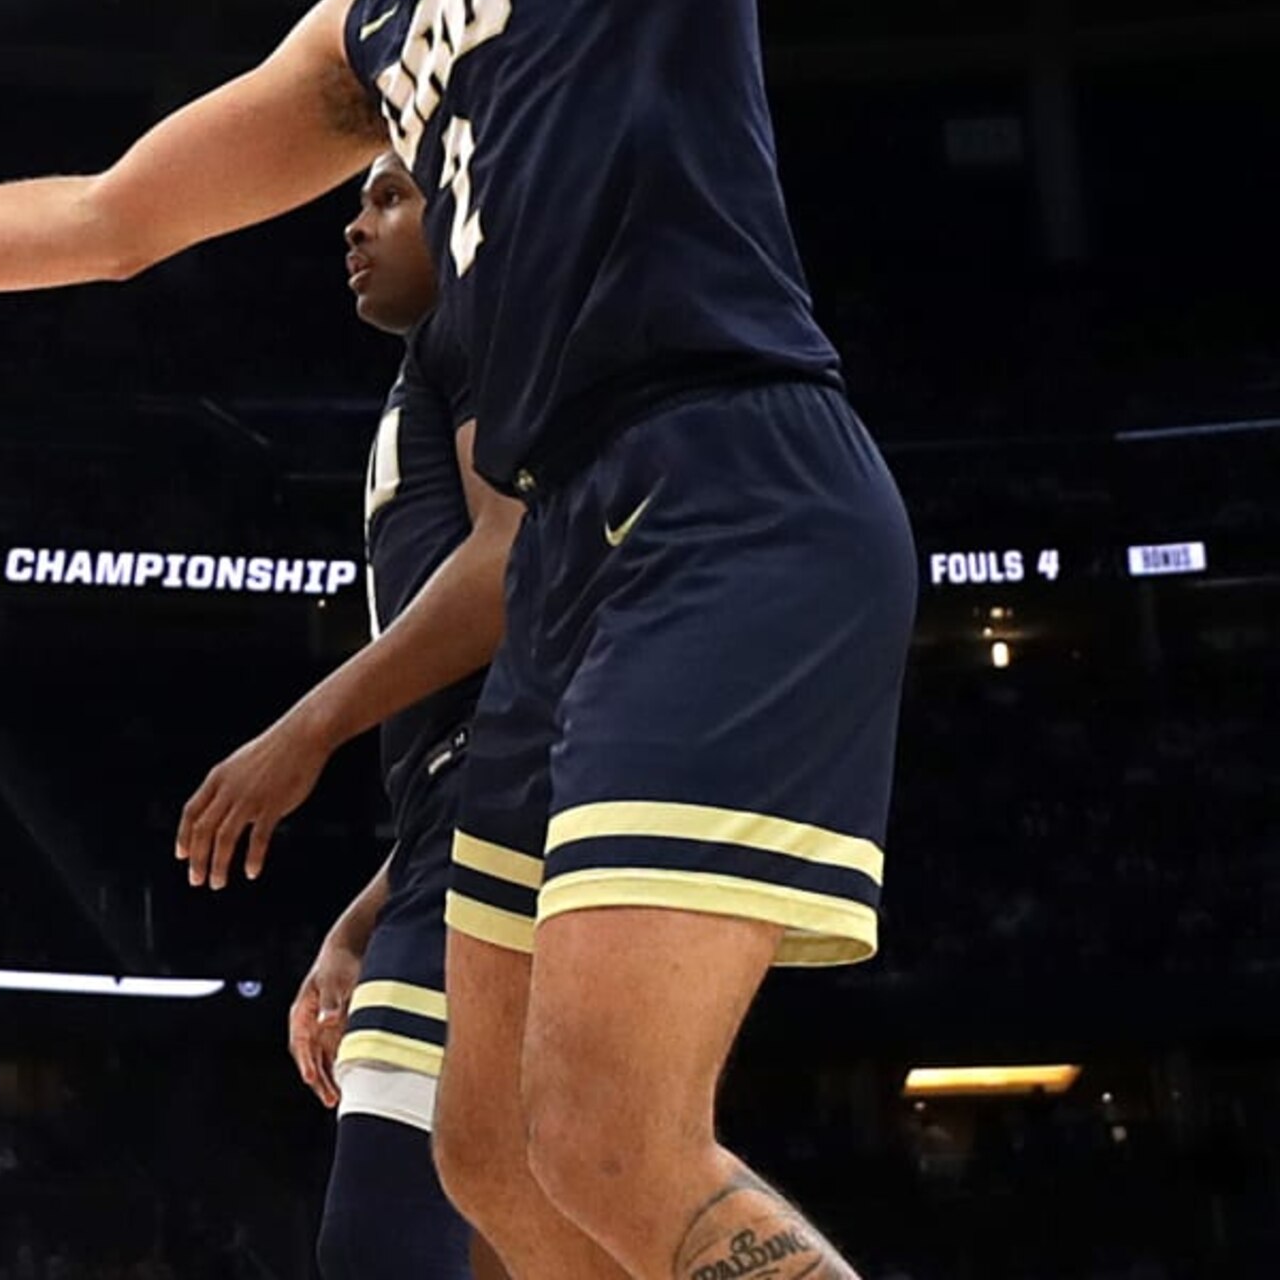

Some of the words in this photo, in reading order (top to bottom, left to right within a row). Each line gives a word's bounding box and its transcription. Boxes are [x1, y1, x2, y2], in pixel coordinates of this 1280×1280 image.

[5, 547, 357, 595] CHAMPIONSHIP
[930, 549, 1024, 584] FOULS
[1037, 548, 1059, 581] 4
